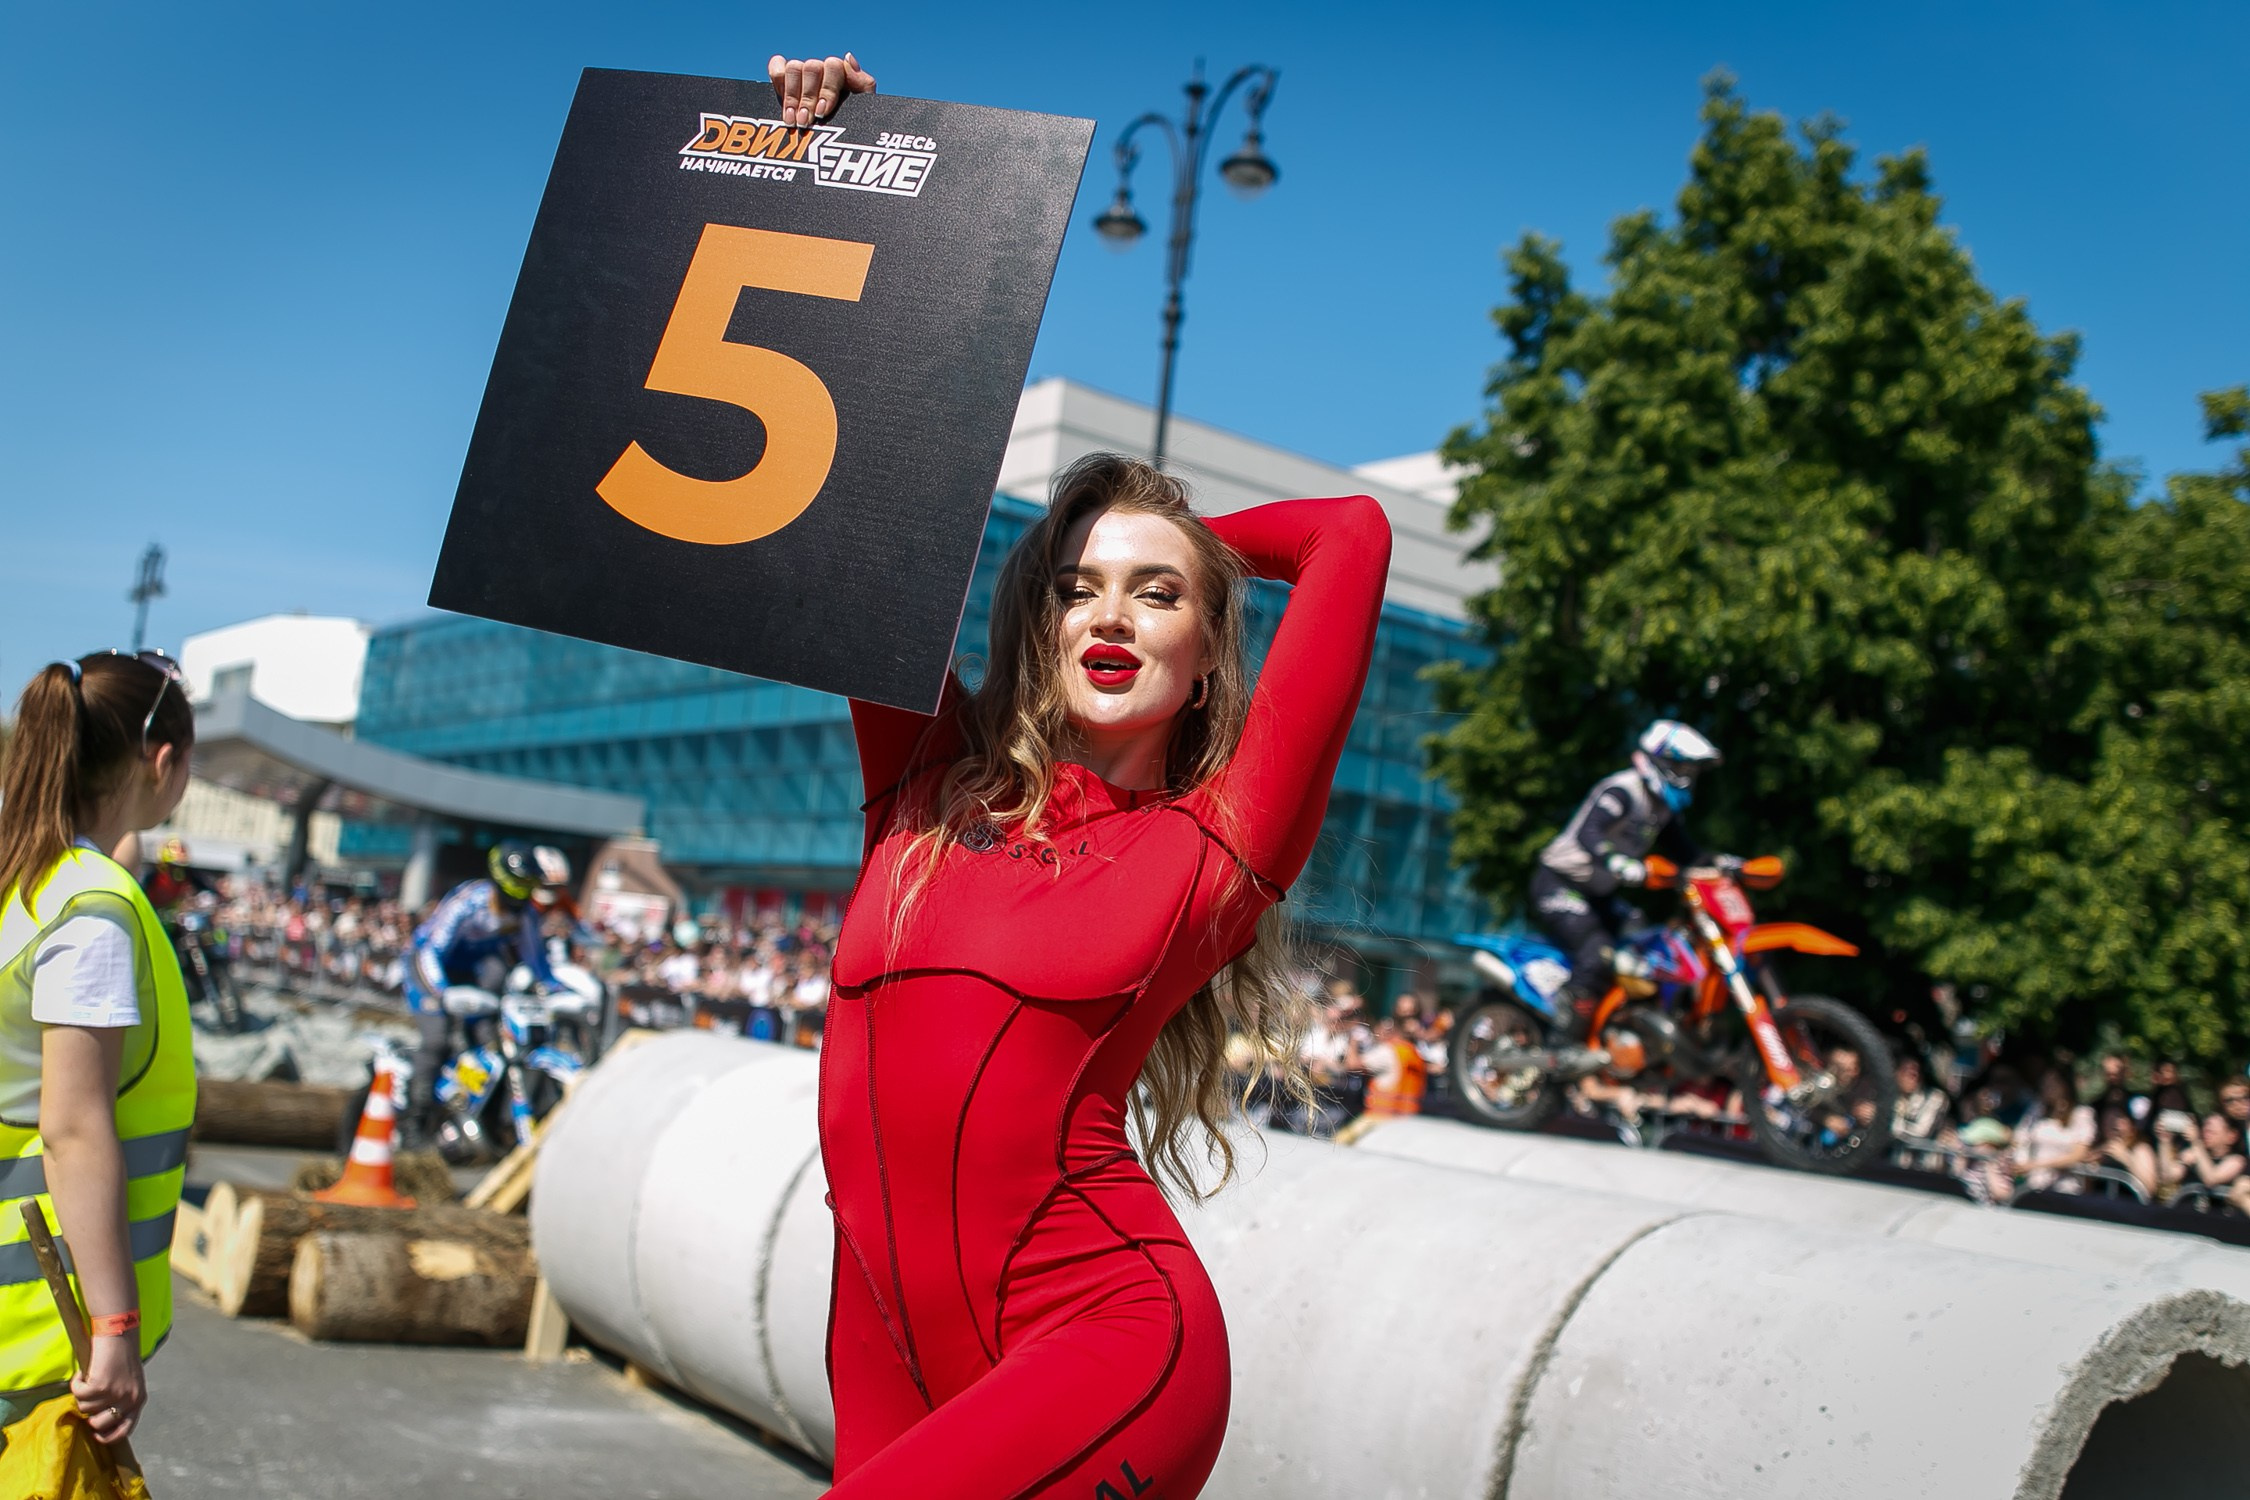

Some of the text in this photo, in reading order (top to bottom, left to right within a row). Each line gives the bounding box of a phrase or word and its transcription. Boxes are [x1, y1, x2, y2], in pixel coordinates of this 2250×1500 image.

[875, 132, 938, 151] ЗДЕСЬ
[679, 156, 797, 182] НАЧИНАЕТСЯ
[595, 222, 876, 545] 5
